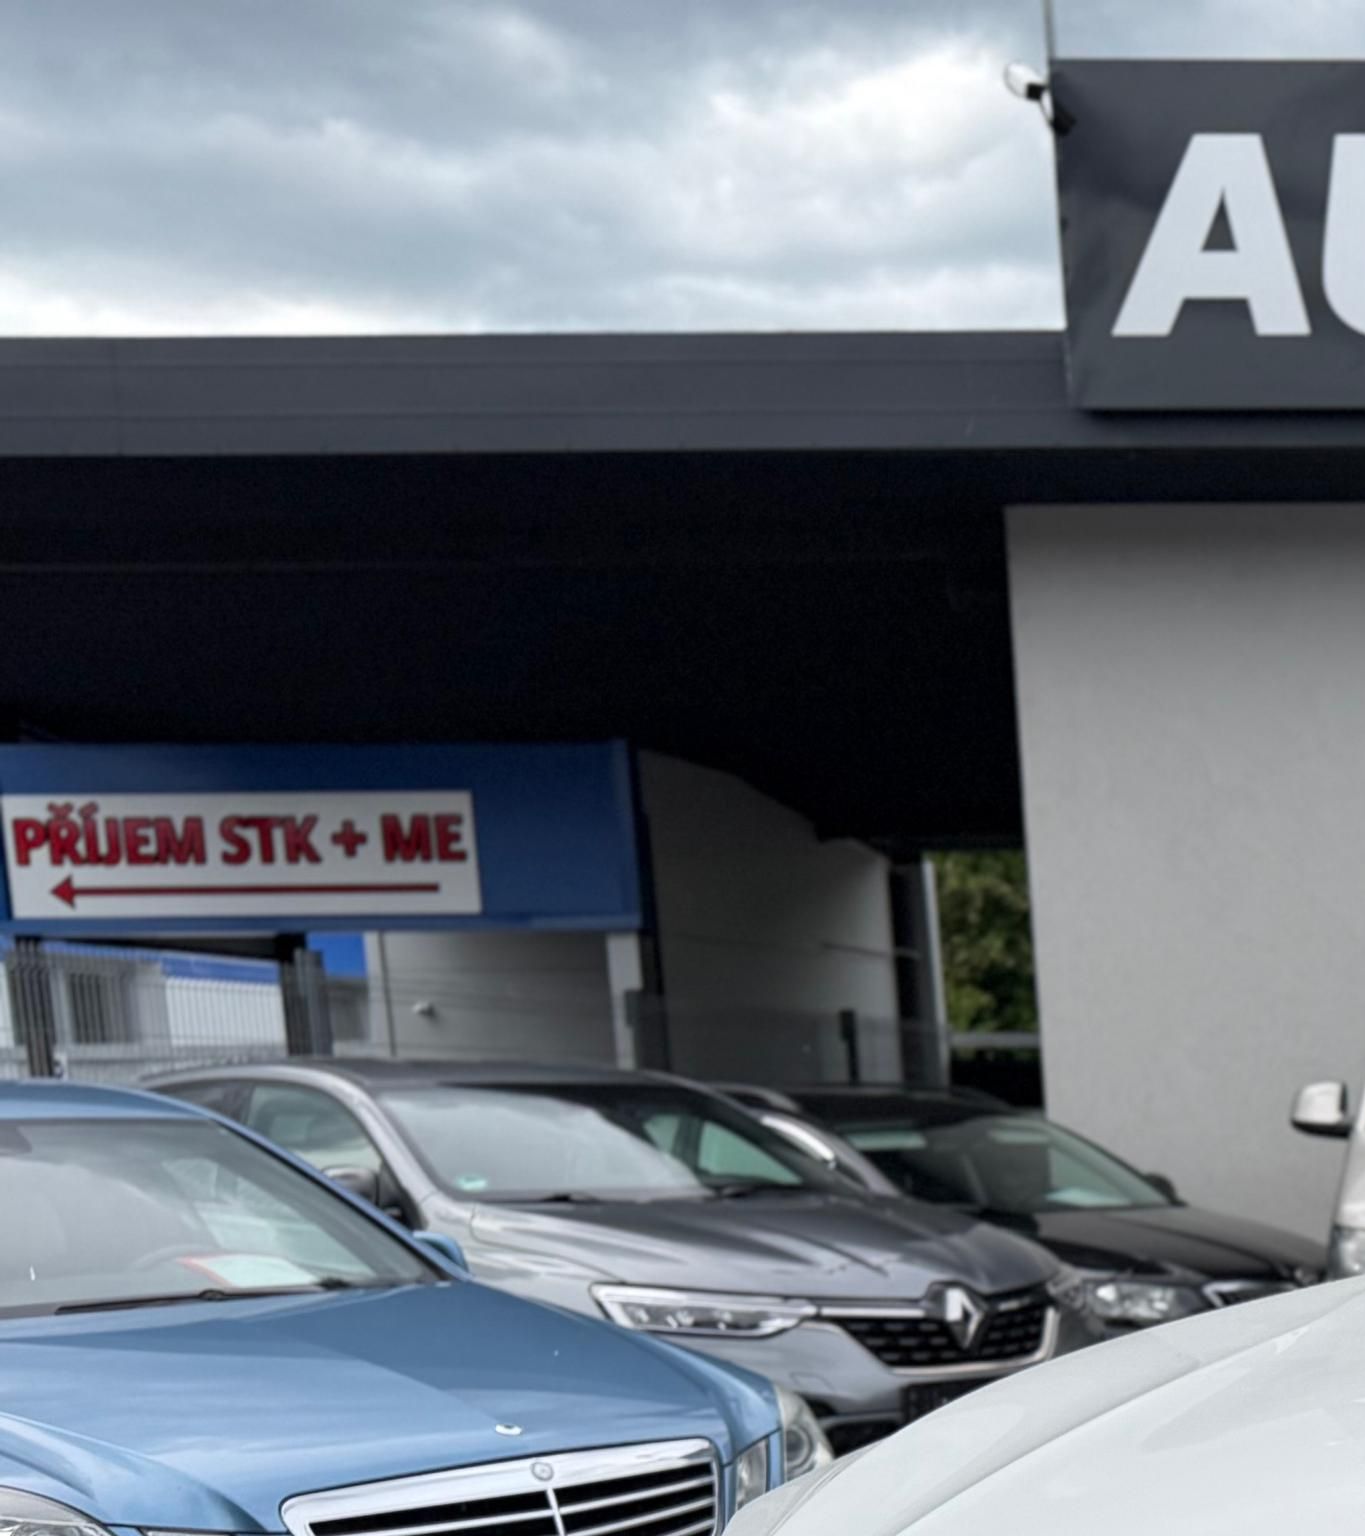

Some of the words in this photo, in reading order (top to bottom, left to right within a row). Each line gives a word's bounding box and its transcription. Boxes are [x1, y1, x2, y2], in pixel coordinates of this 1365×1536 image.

[12, 802, 206, 866] PŘÍJEM
[218, 814, 322, 865] STK
[379, 813, 467, 863] ME
